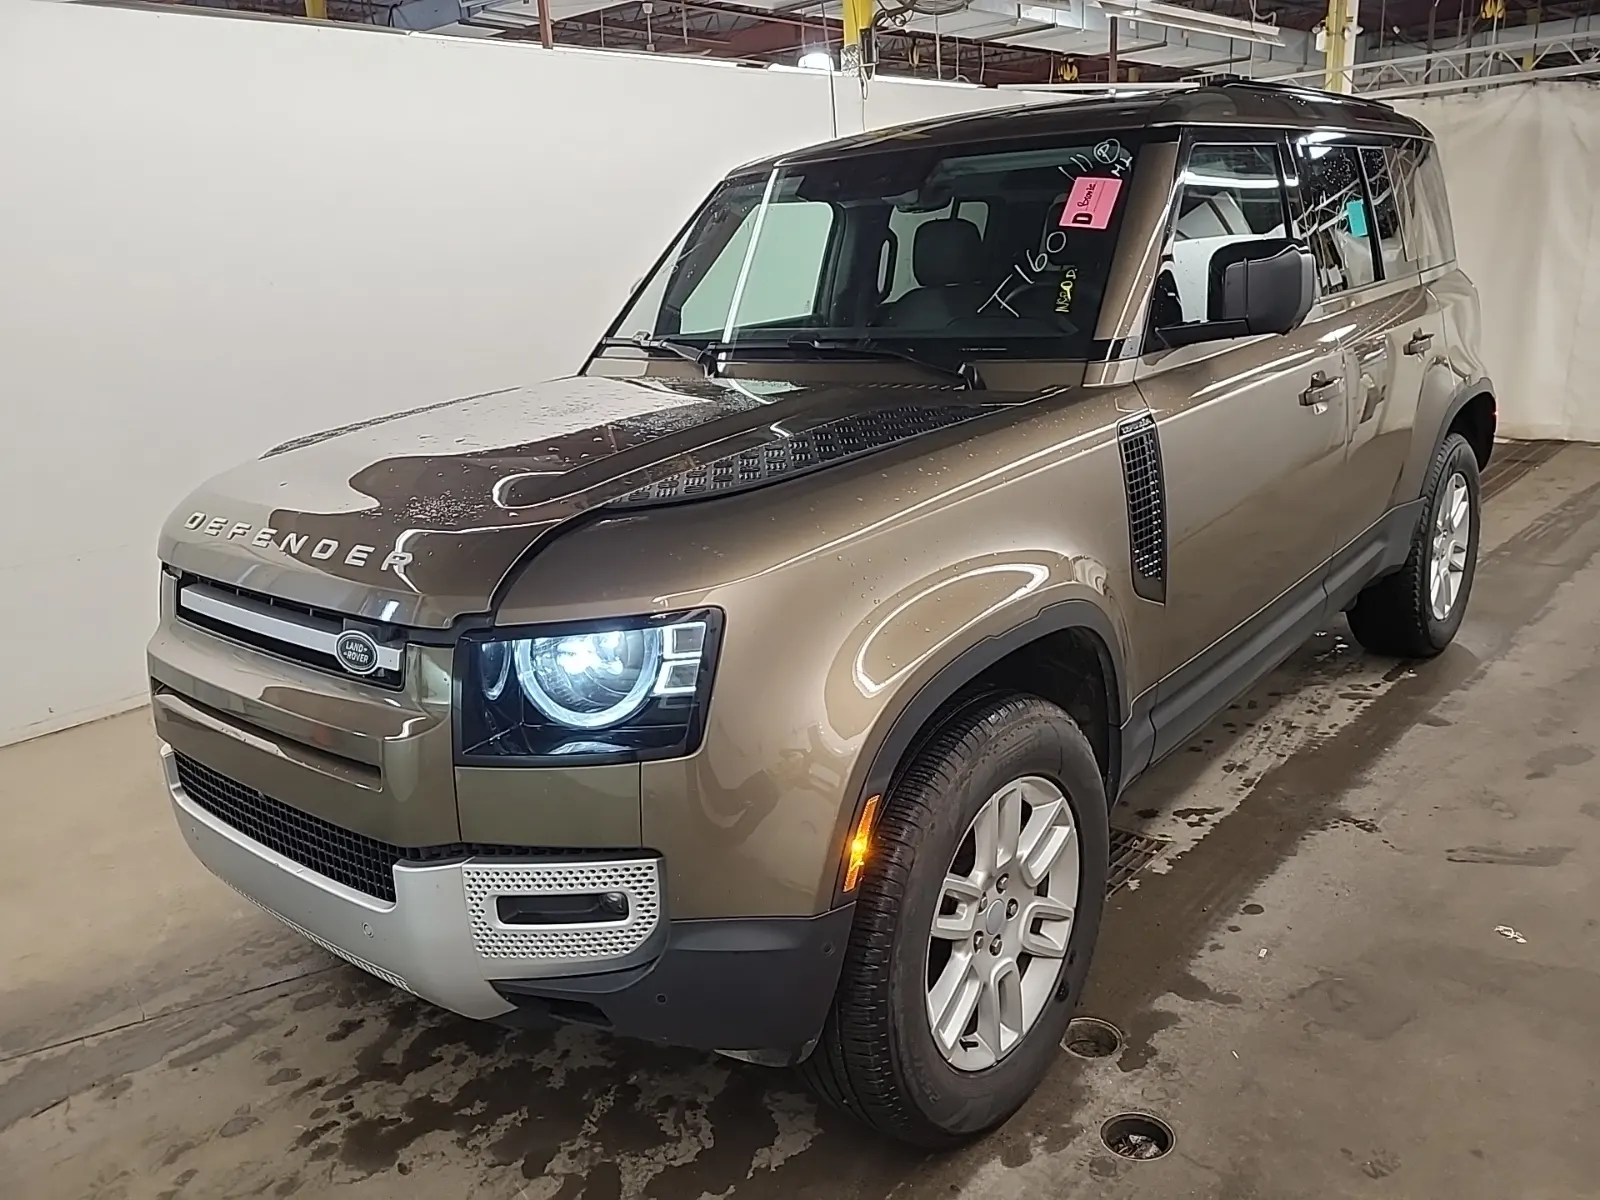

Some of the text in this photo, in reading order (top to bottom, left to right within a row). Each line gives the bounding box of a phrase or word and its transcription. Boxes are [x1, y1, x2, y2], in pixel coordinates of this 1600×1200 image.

[1072, 213, 1093, 225] D
[184, 511, 413, 574] DEFENDER
[345, 641, 364, 652] LAND
[346, 651, 369, 663] ROVER
